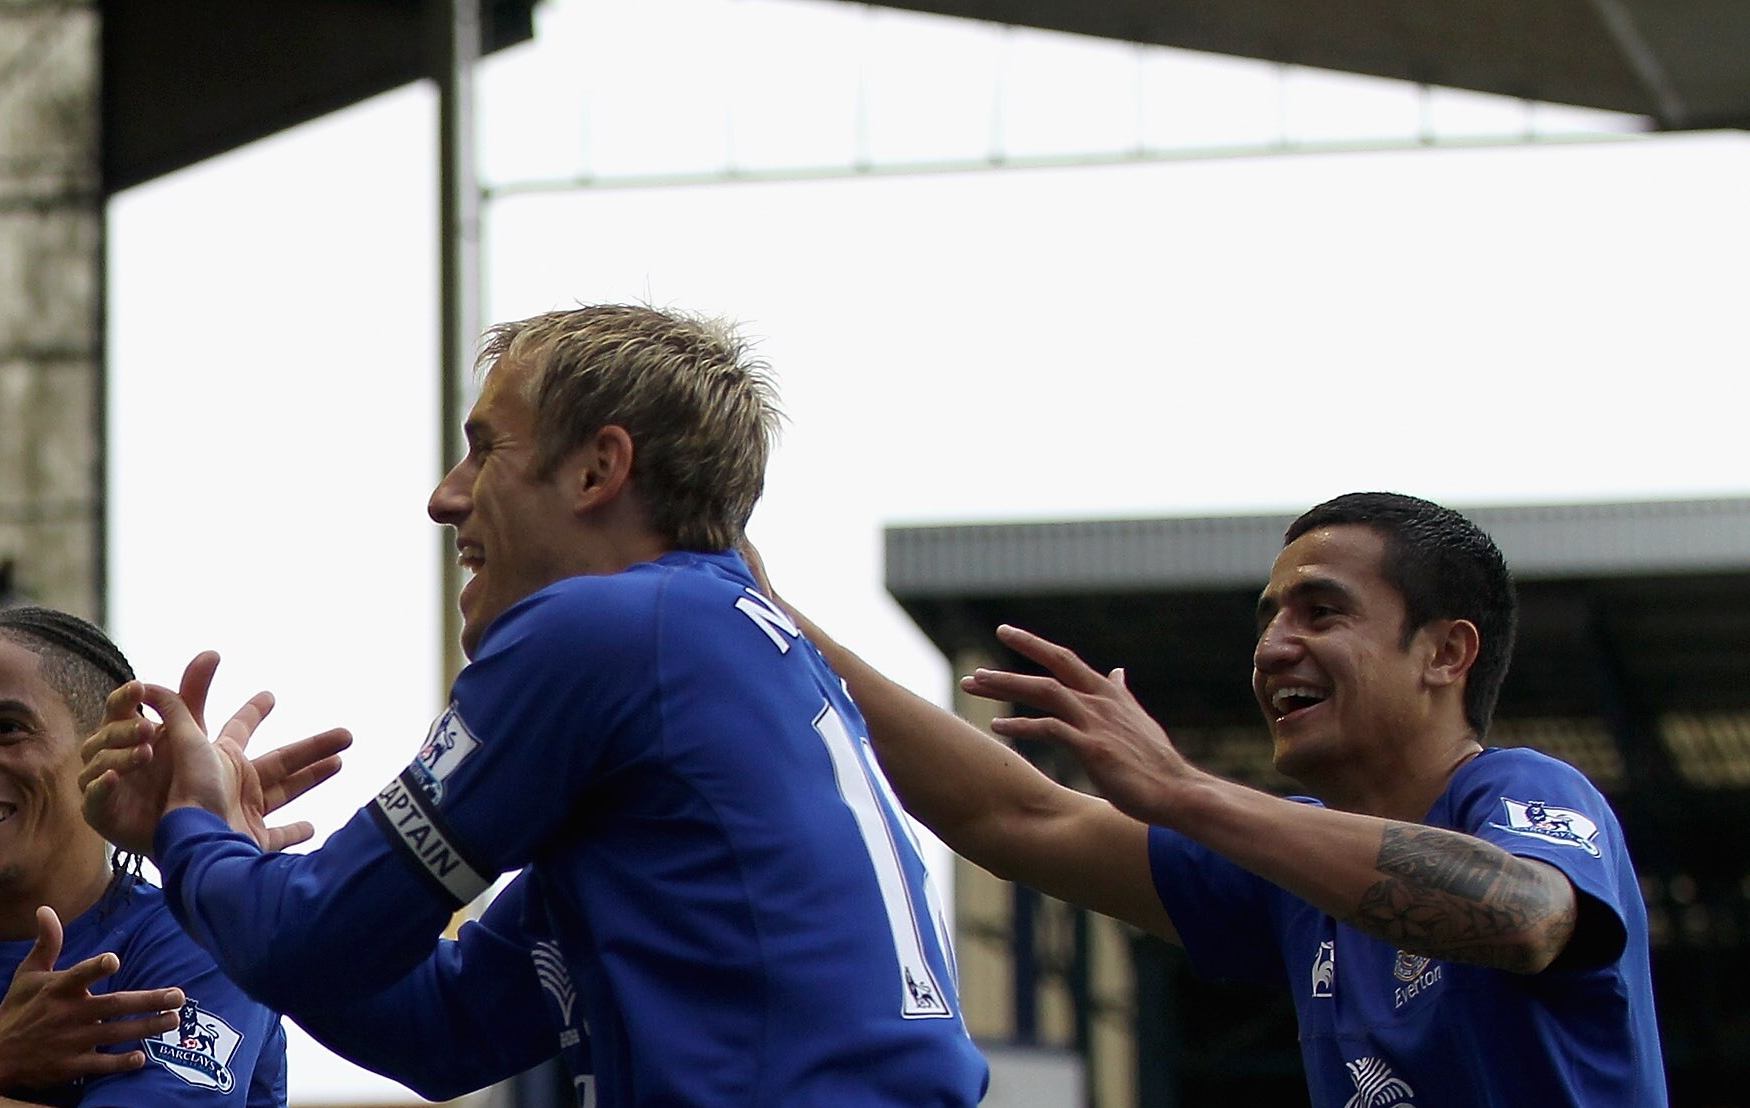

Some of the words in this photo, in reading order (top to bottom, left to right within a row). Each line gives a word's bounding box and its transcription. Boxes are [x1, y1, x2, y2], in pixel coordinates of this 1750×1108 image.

[379, 779, 461, 878] APTAIN
[1394, 965, 1443, 1009] Everton
[158, 1045, 216, 1071] BARCLAYS
